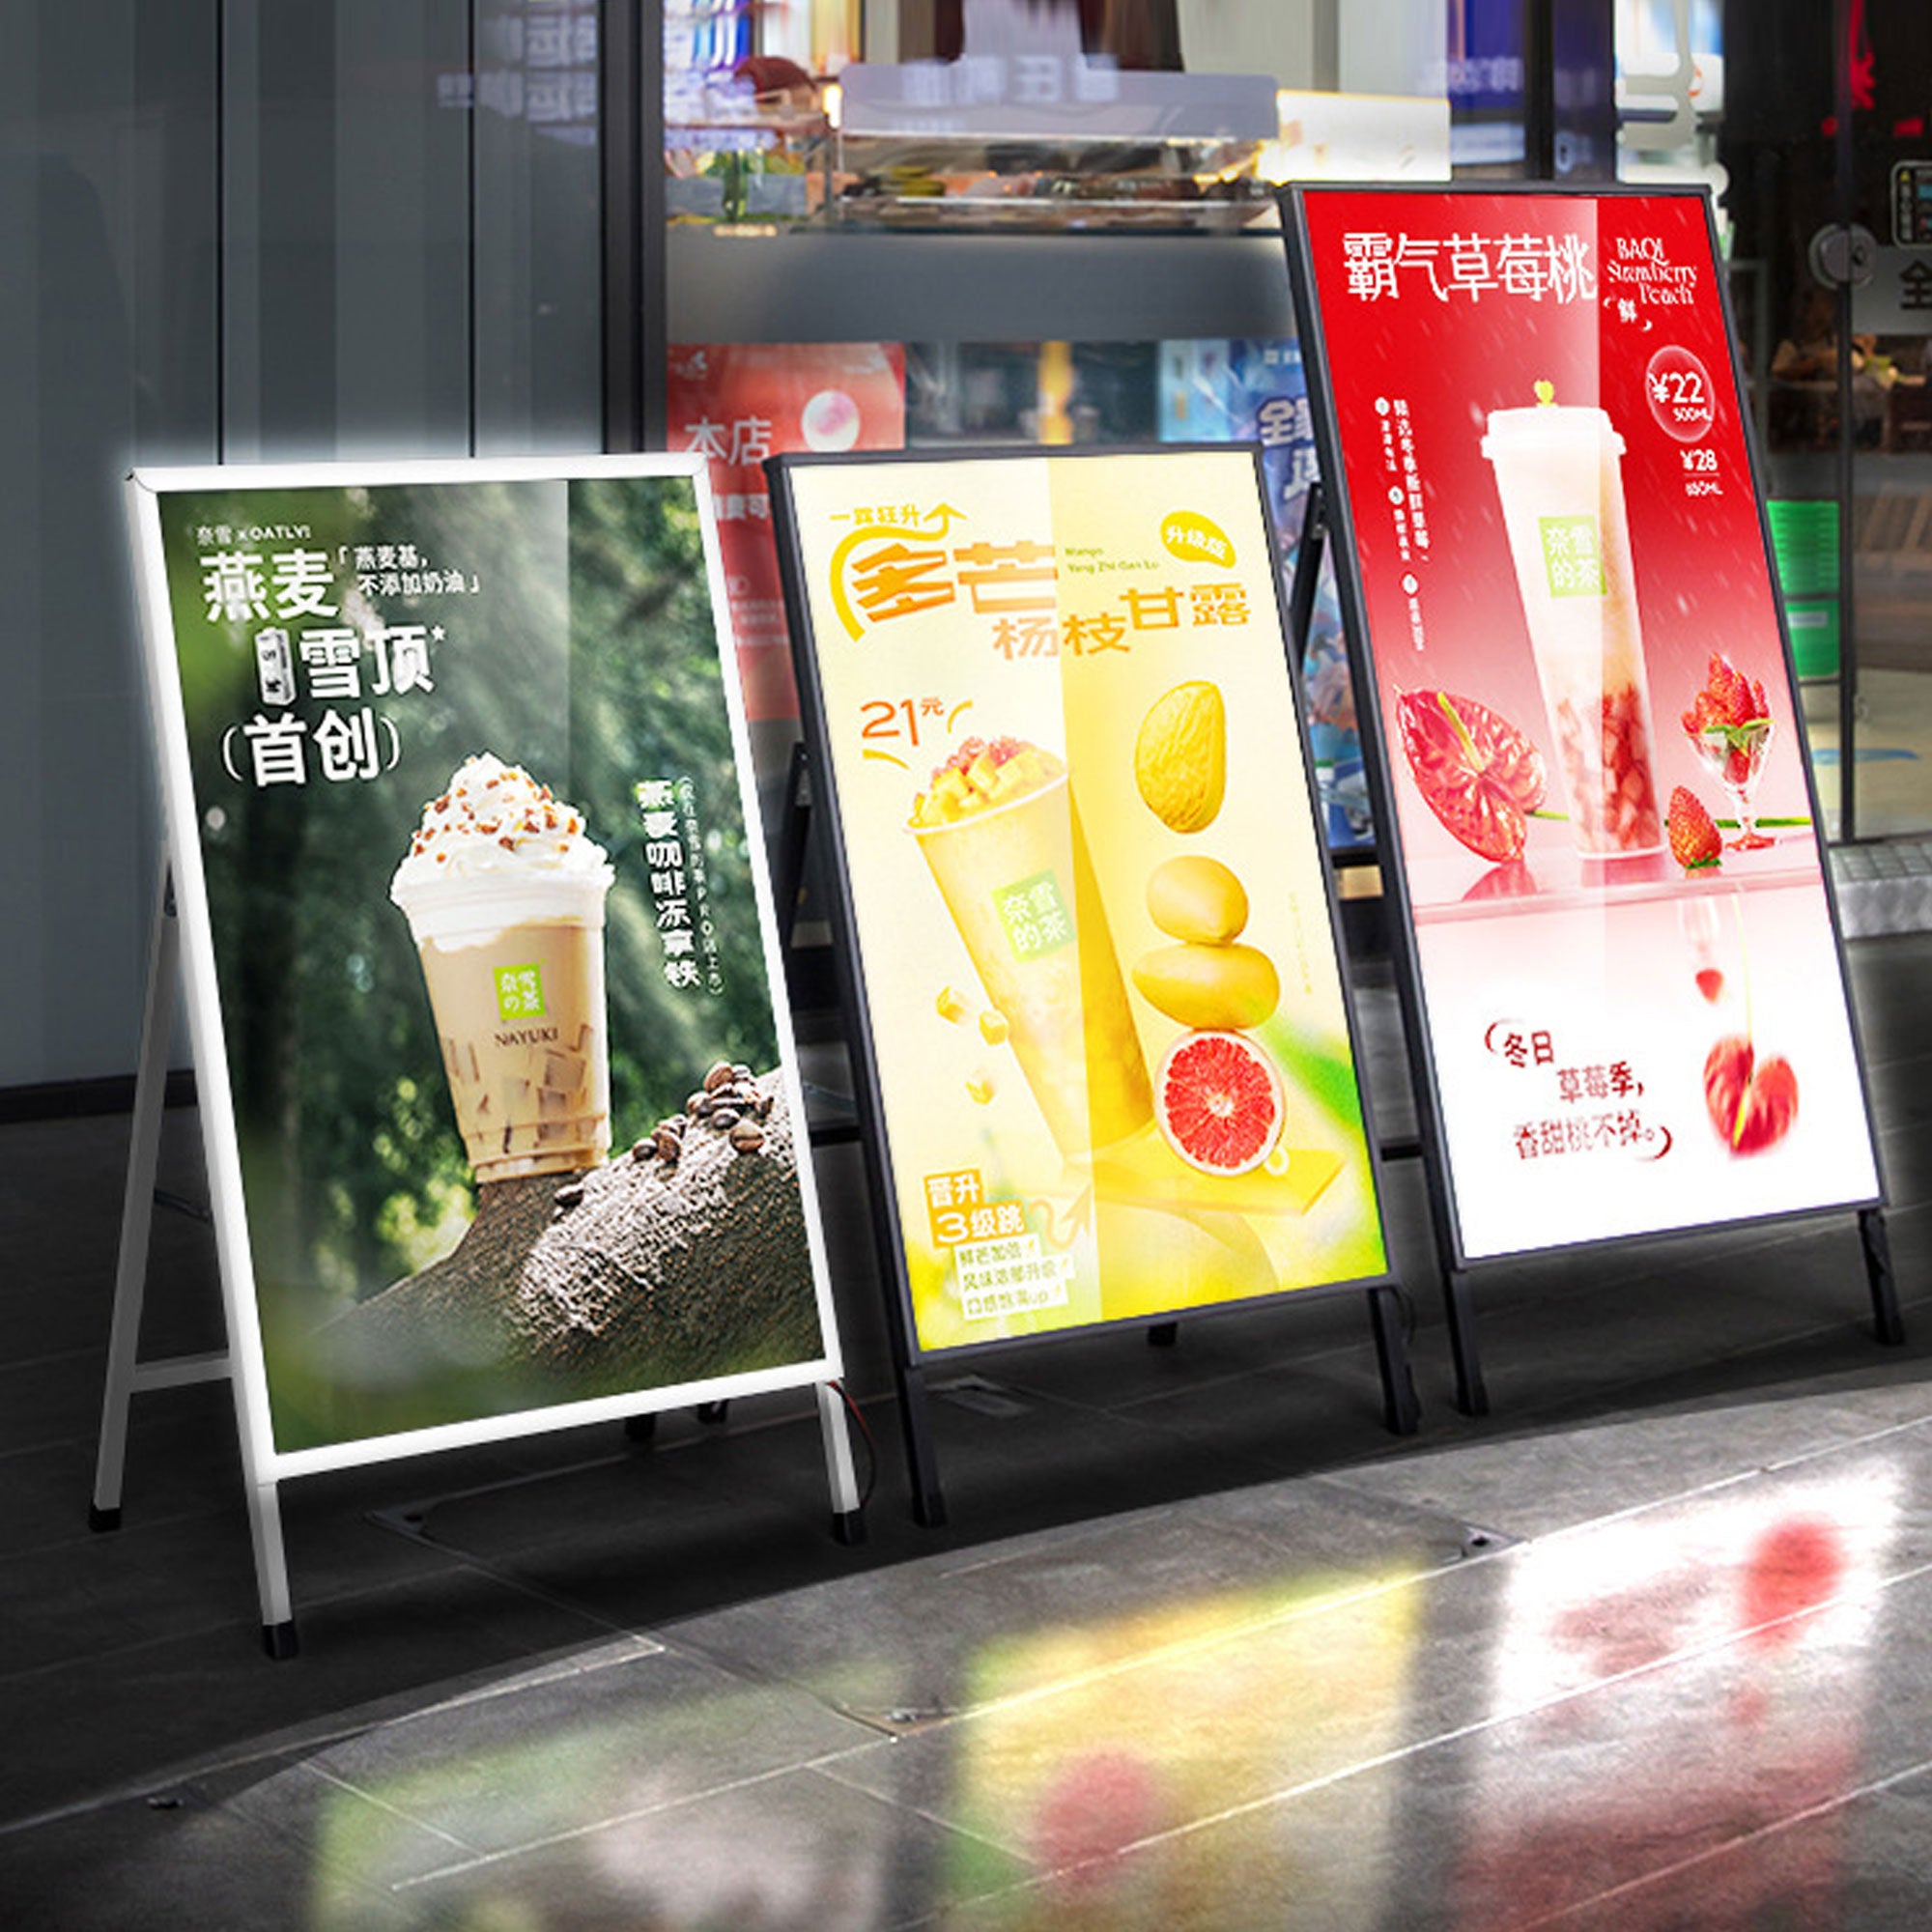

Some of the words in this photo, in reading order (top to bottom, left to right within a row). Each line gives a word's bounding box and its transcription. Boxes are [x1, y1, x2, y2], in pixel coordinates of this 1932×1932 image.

[1342, 233, 1598, 304] 霸气草莓桃
[1648, 371, 1705, 404] ¥22
[685, 414, 772, 466] 本店
[1680, 448, 1719, 471] ¥28
[199, 548, 339, 622] 燕麦
[993, 582, 1251, 661] 杨枝甘露
[222, 707, 401, 787] (首创)
[494, 1027, 558, 1045] NAYUKI
[926, 1173, 980, 1208] 晋升
[935, 1205, 1025, 1243] 3级跳
